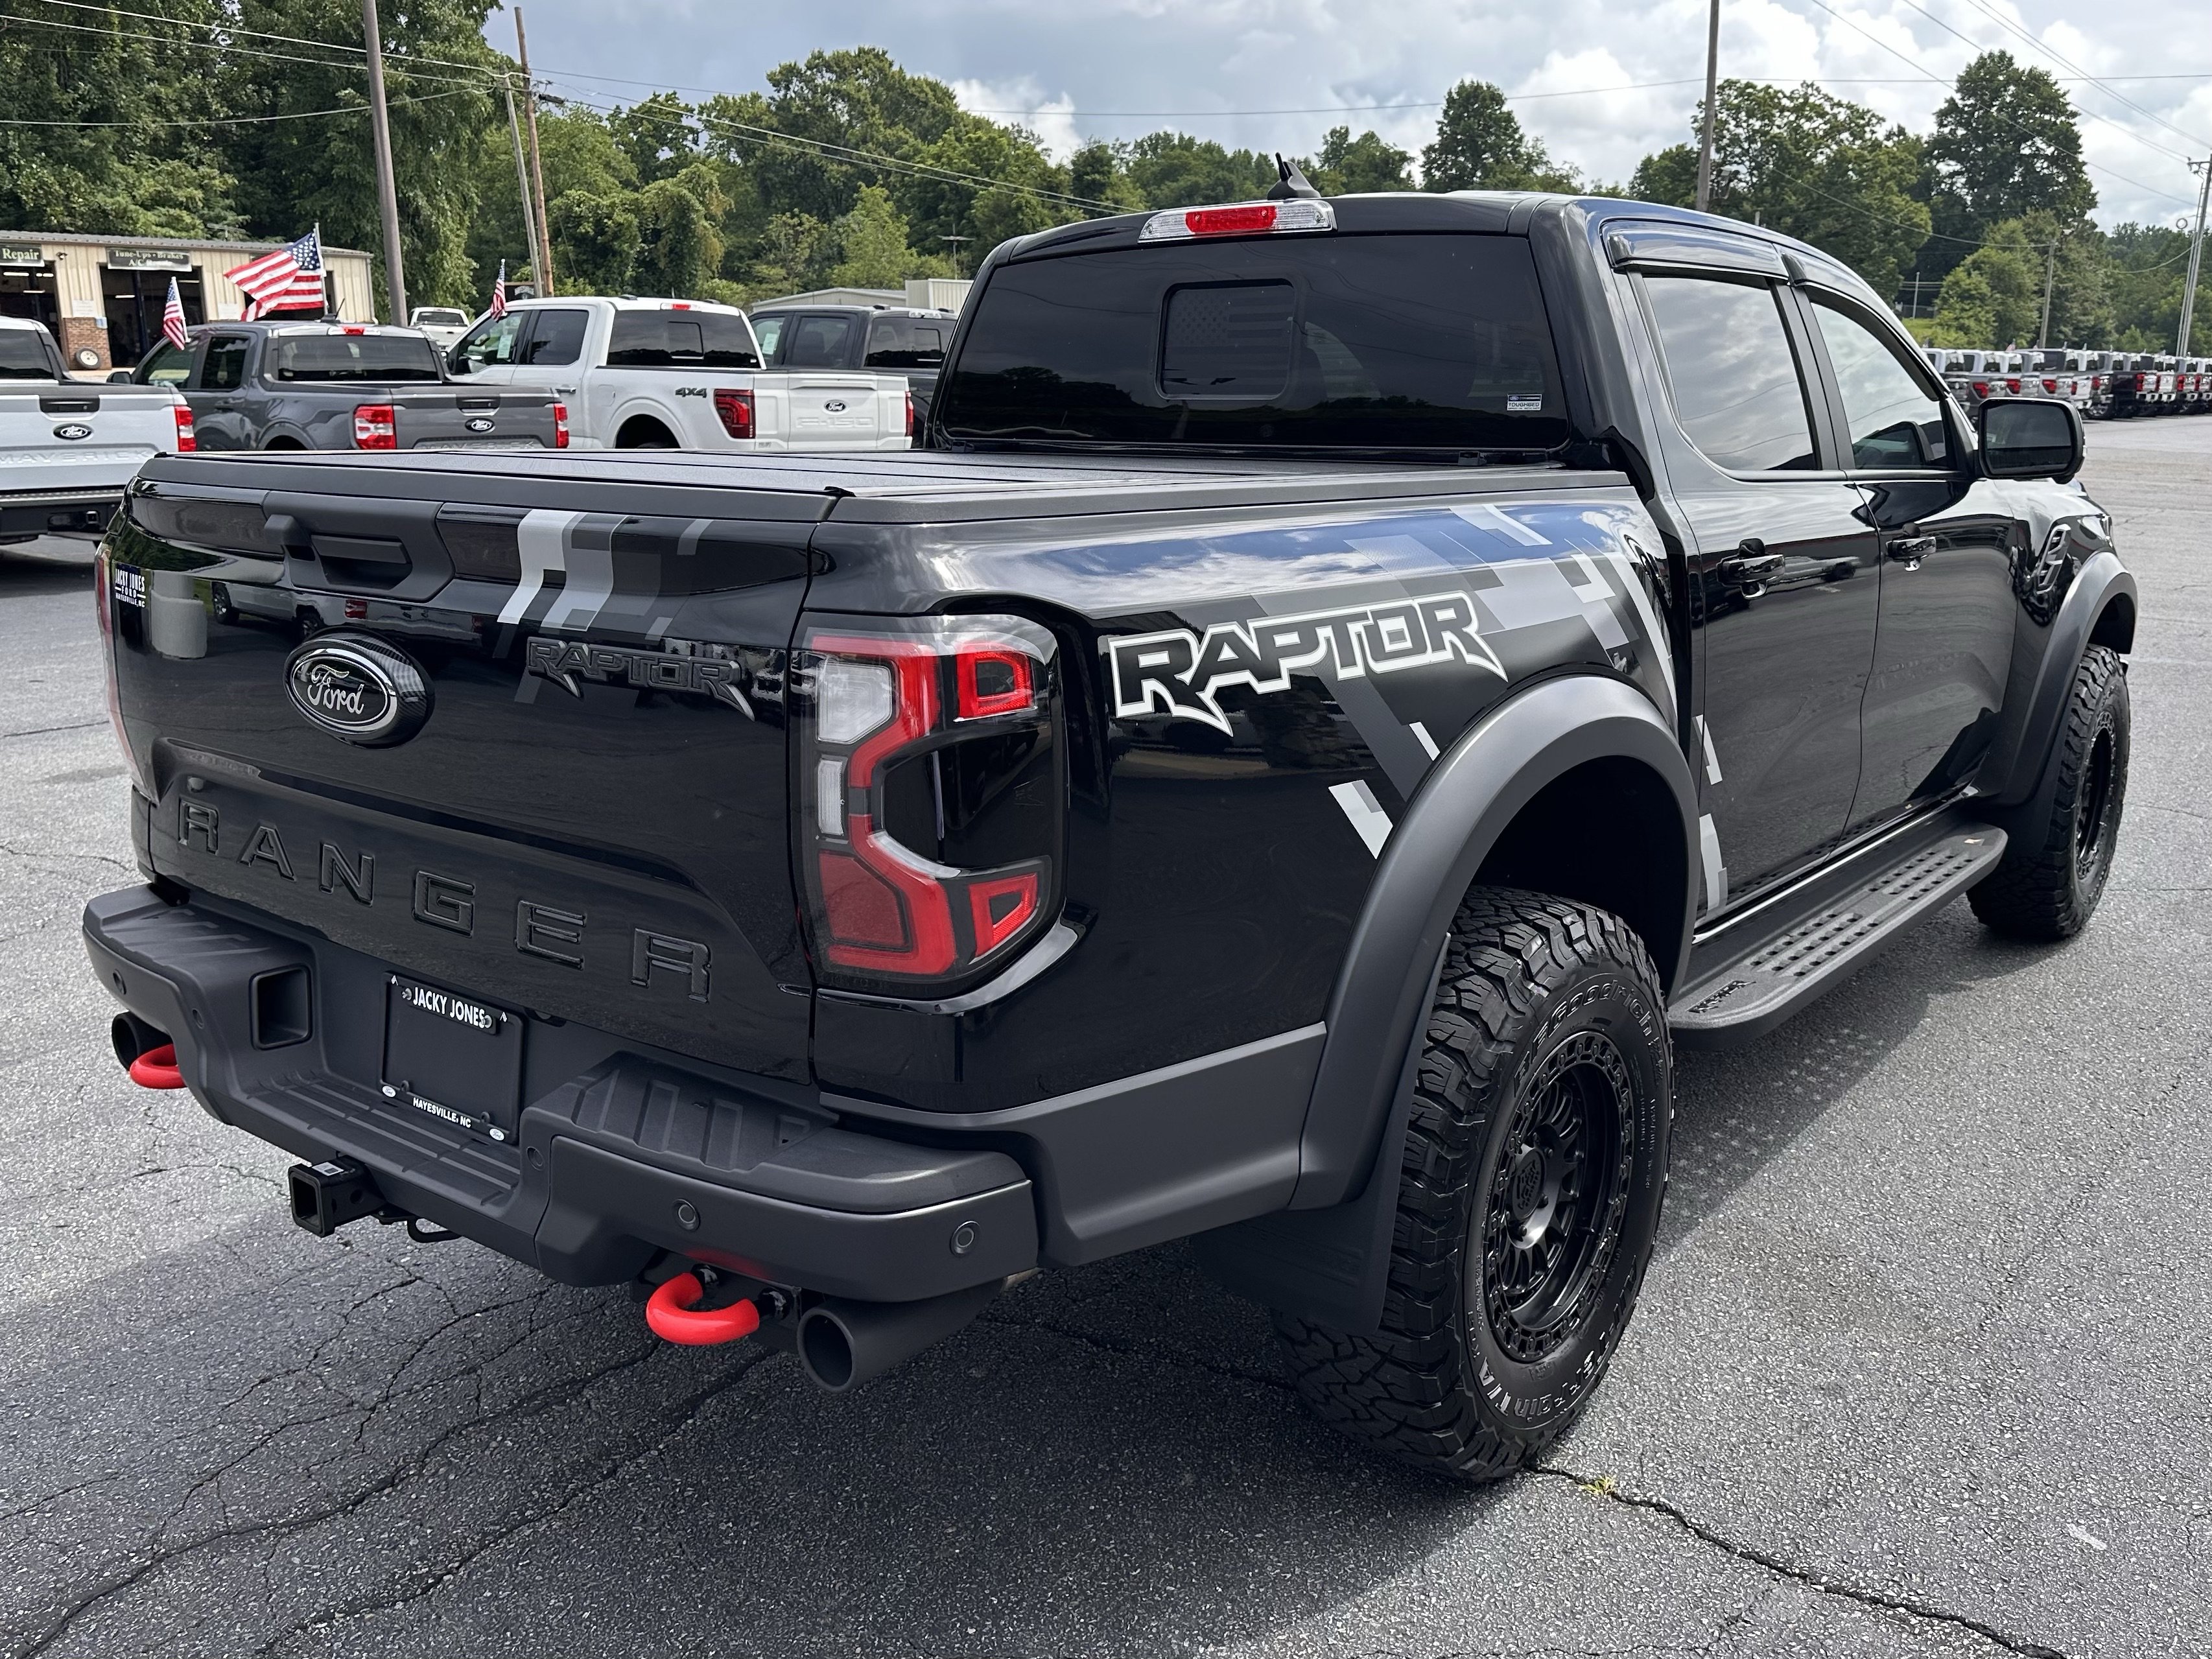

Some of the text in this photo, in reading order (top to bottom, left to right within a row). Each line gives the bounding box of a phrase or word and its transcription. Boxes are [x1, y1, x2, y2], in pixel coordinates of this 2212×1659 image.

[2, 248, 40, 263] Repair
[128, 259, 144, 267] A/C
[121, 585, 137, 598] FORD
[130, 572, 145, 593] JONES
[526, 636, 755, 721] RAPTOR
[1107, 590, 1508, 737] RAPTOR
[307, 664, 366, 715] Ford
[177, 798, 712, 1004] RANGER
[412, 987, 486, 1029] JACKY JONES
[412, 1097, 471, 1128] HAYESVILLE, NC
